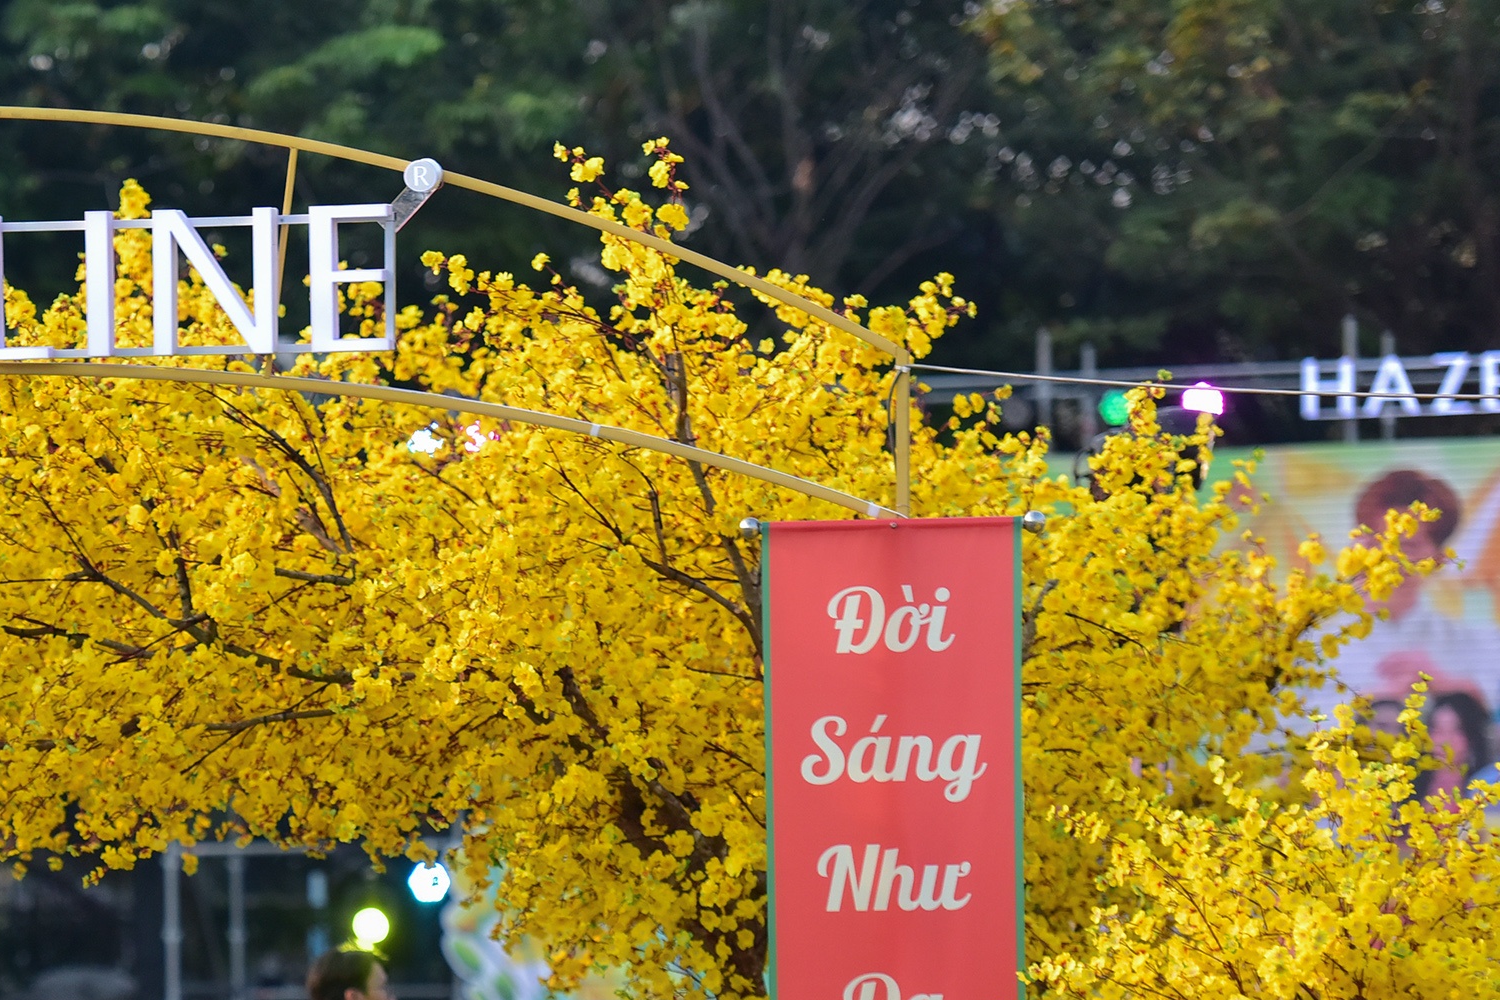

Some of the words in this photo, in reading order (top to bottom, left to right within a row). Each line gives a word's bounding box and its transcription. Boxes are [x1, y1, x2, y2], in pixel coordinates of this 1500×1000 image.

[827, 584, 956, 656] Đời
[800, 715, 988, 803] Sáng
[817, 844, 972, 912] Như
